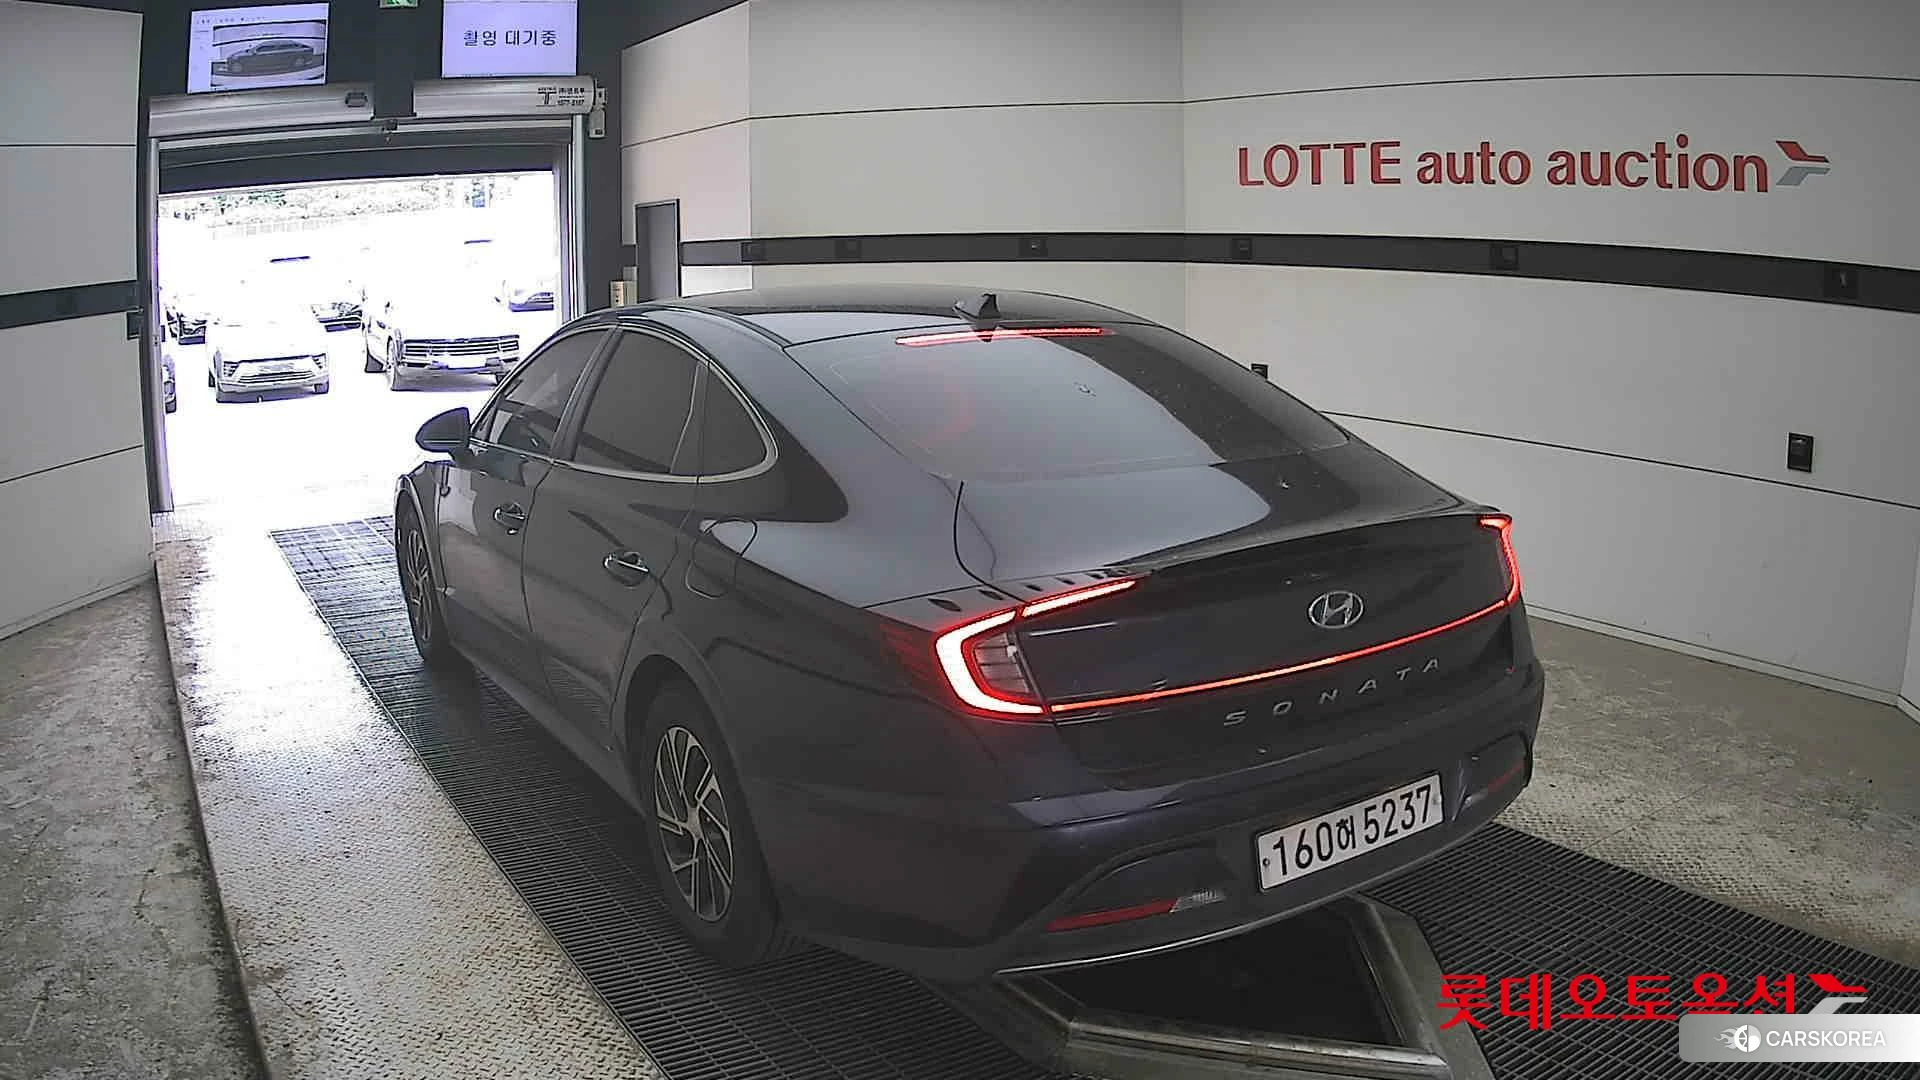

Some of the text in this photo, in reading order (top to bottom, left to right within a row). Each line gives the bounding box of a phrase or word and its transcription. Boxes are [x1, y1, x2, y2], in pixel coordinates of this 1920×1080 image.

[463, 29, 557, 47] 촬영 대기중
[1239, 134, 1768, 193] LOTTE auto auction
[1223, 658, 1439, 726] SONATA
